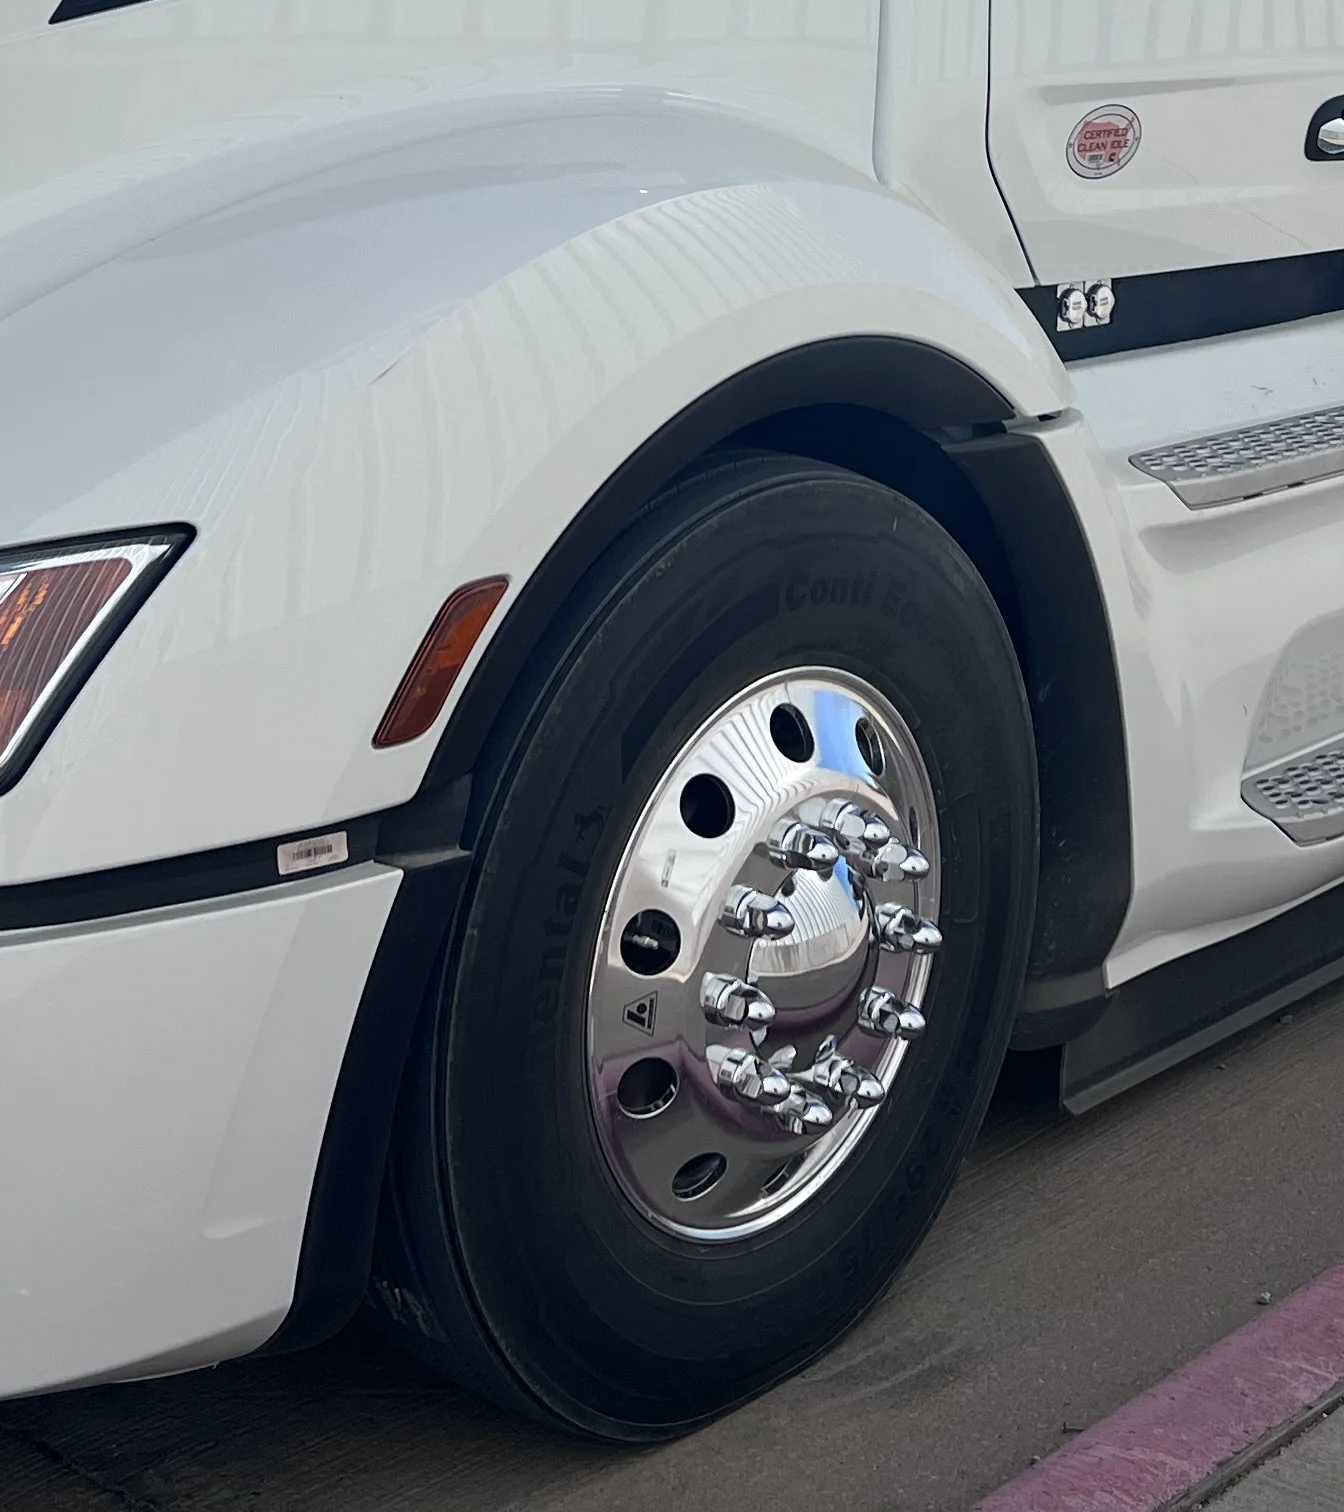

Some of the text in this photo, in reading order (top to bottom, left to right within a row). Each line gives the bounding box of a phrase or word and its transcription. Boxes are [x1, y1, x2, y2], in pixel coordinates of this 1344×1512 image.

[1083, 127, 1129, 141] CERTIFIED
[1077, 138, 1131, 153] CLEAN IDLE
[785, 569, 877, 611] Conti
